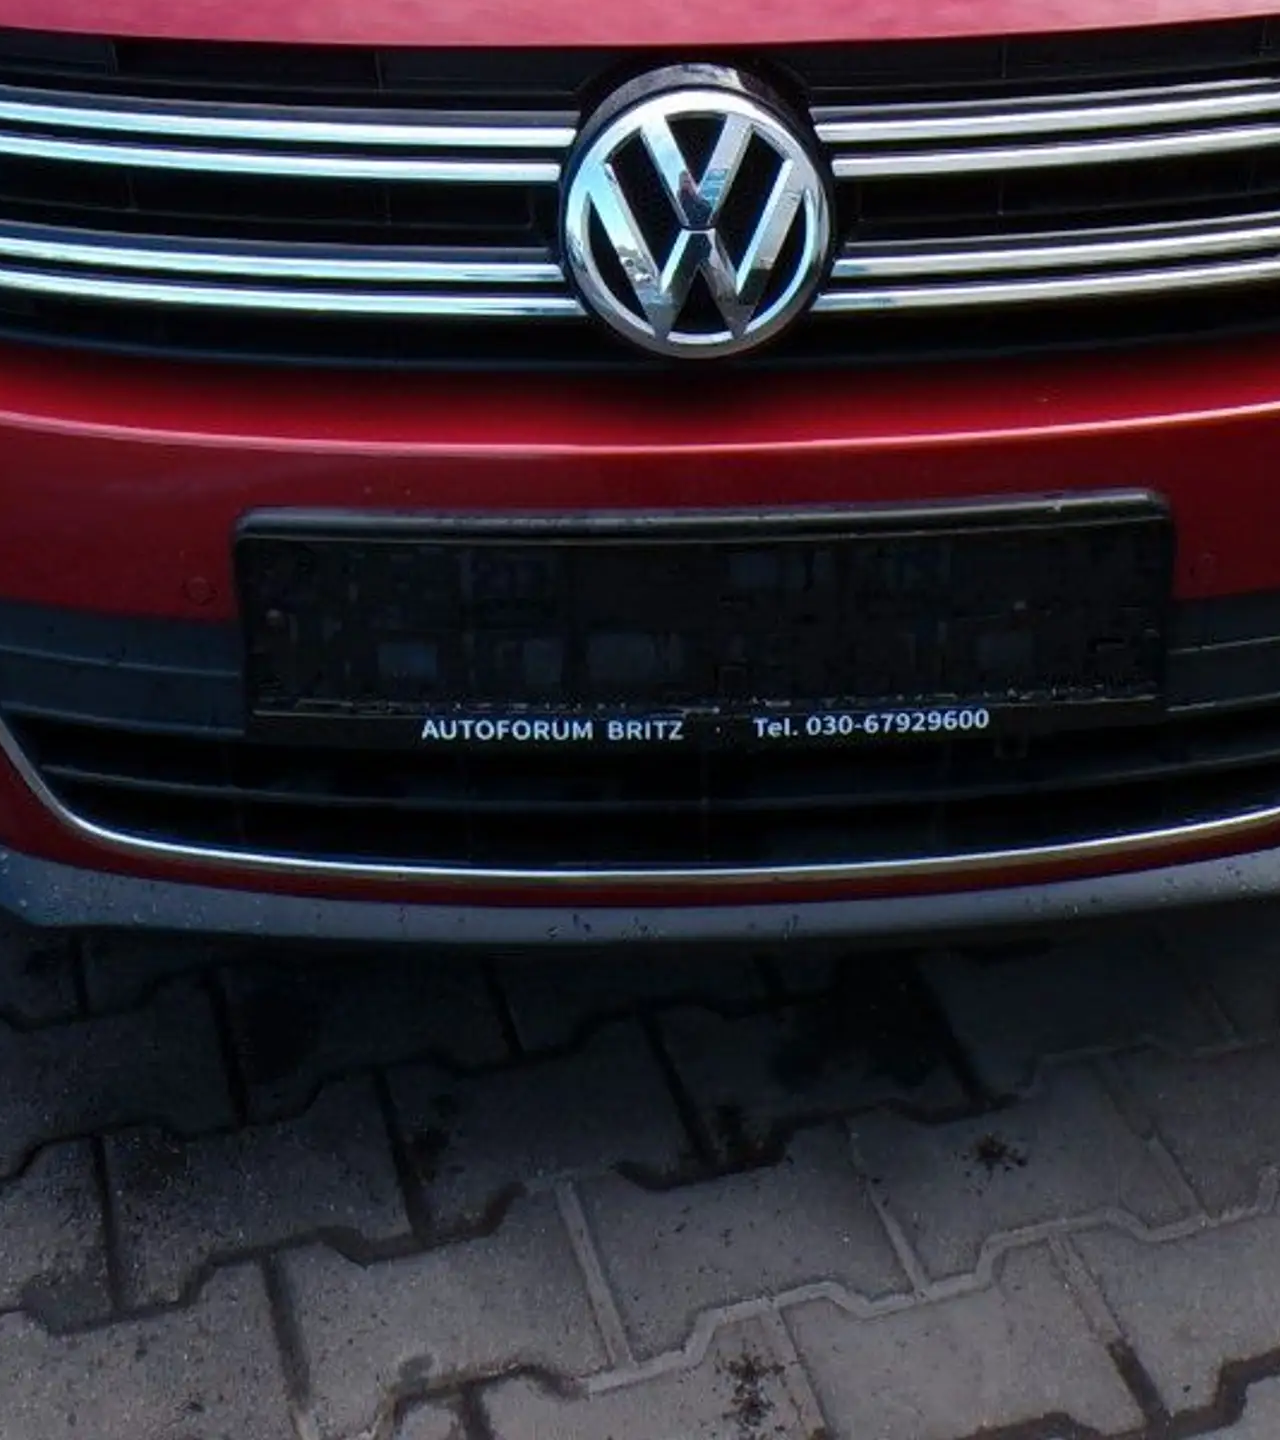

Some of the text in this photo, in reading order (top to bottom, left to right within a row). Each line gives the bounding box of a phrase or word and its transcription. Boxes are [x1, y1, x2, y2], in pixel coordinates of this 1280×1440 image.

[421, 708, 990, 741] AUTOFORUM BRITZ Tel. 030-67929600
